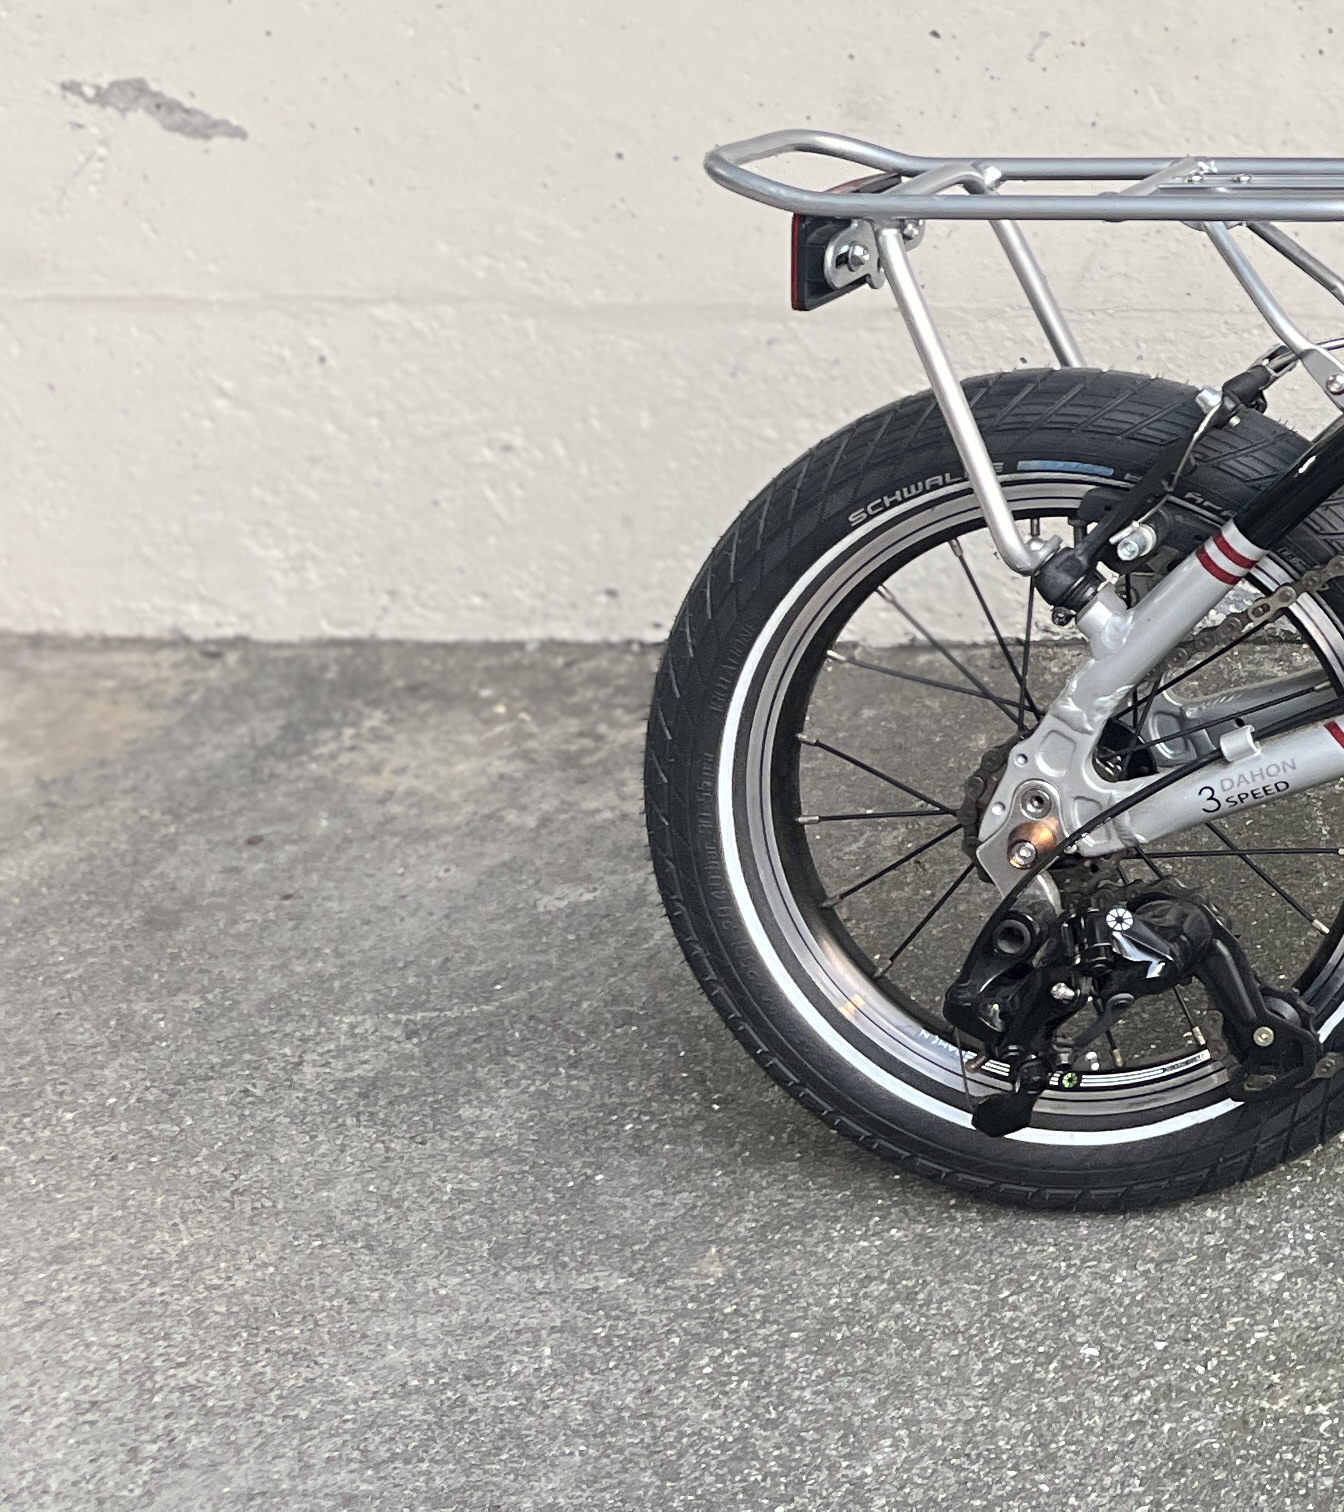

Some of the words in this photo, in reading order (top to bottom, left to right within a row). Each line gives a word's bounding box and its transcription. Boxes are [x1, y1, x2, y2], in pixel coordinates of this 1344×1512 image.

[847, 461, 1005, 527] SCHWALE
[1219, 756, 1298, 793] DAHON
[1198, 786, 1223, 814] 3
[1225, 779, 1291, 809] SPEED
